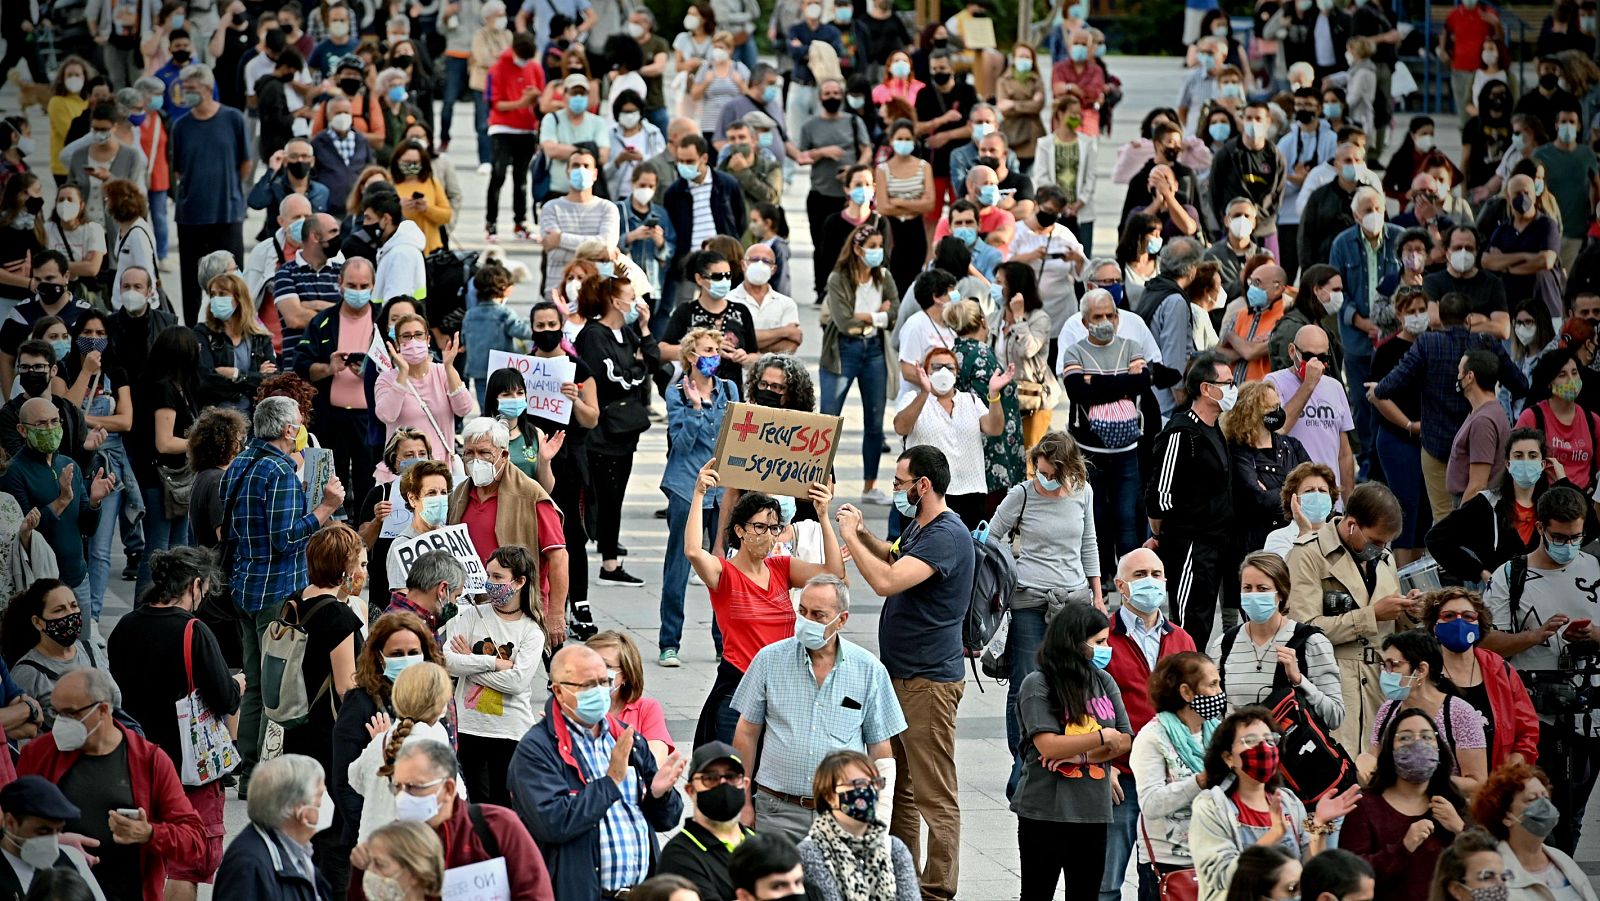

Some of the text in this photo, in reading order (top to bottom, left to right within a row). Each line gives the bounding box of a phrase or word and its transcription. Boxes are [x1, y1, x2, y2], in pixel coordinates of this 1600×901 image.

[507, 356, 551, 377] NO AL
[529, 395, 564, 415] CLASE
[758, 421, 833, 457] recurSOS
[1552, 436, 1572, 449] this
[1571, 449, 1589, 462] life
[744, 454, 825, 484] segregación
[397, 528, 475, 574] ROBAN
